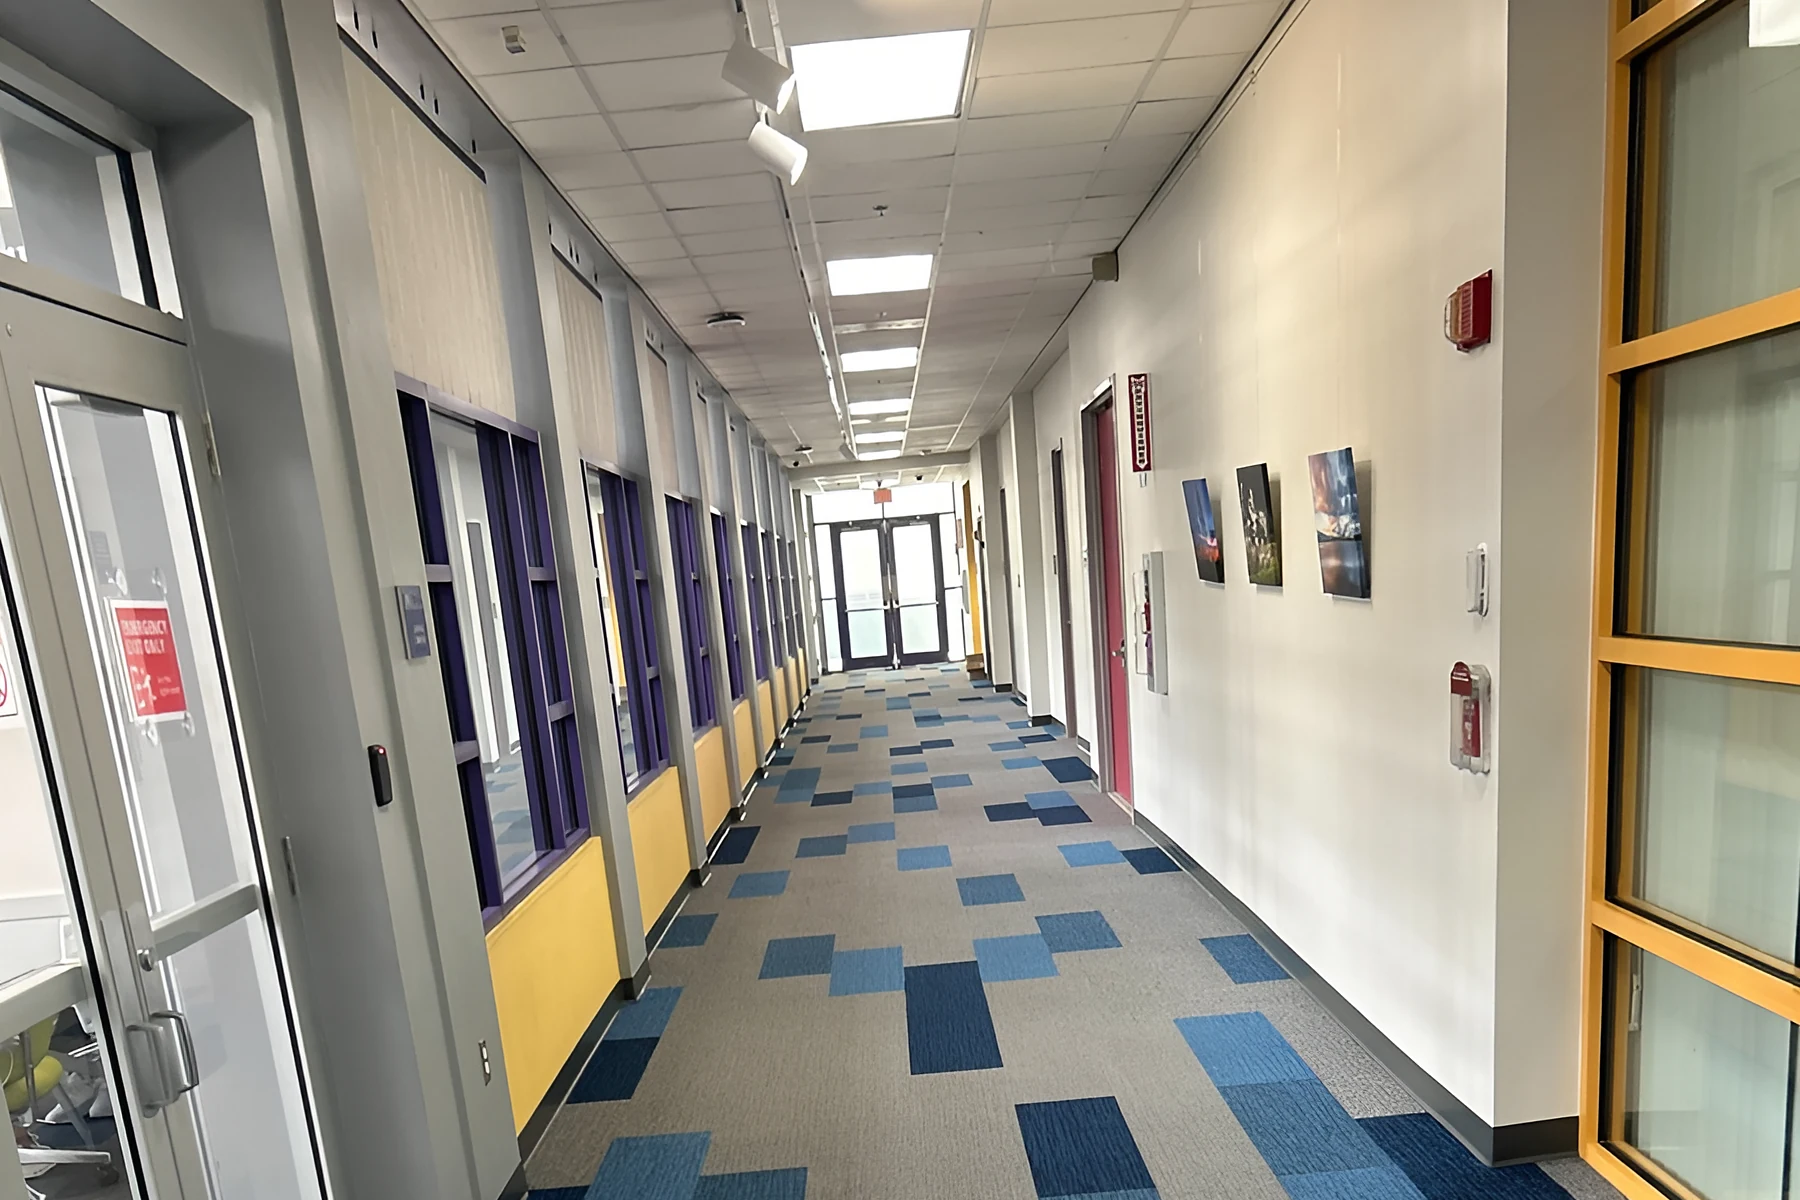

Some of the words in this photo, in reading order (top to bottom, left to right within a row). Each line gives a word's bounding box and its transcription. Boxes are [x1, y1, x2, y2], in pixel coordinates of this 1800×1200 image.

[120, 620, 168, 636] EMERGENCY
[124, 639, 143, 655] EXIT
[143, 638, 166, 654] ONLY
